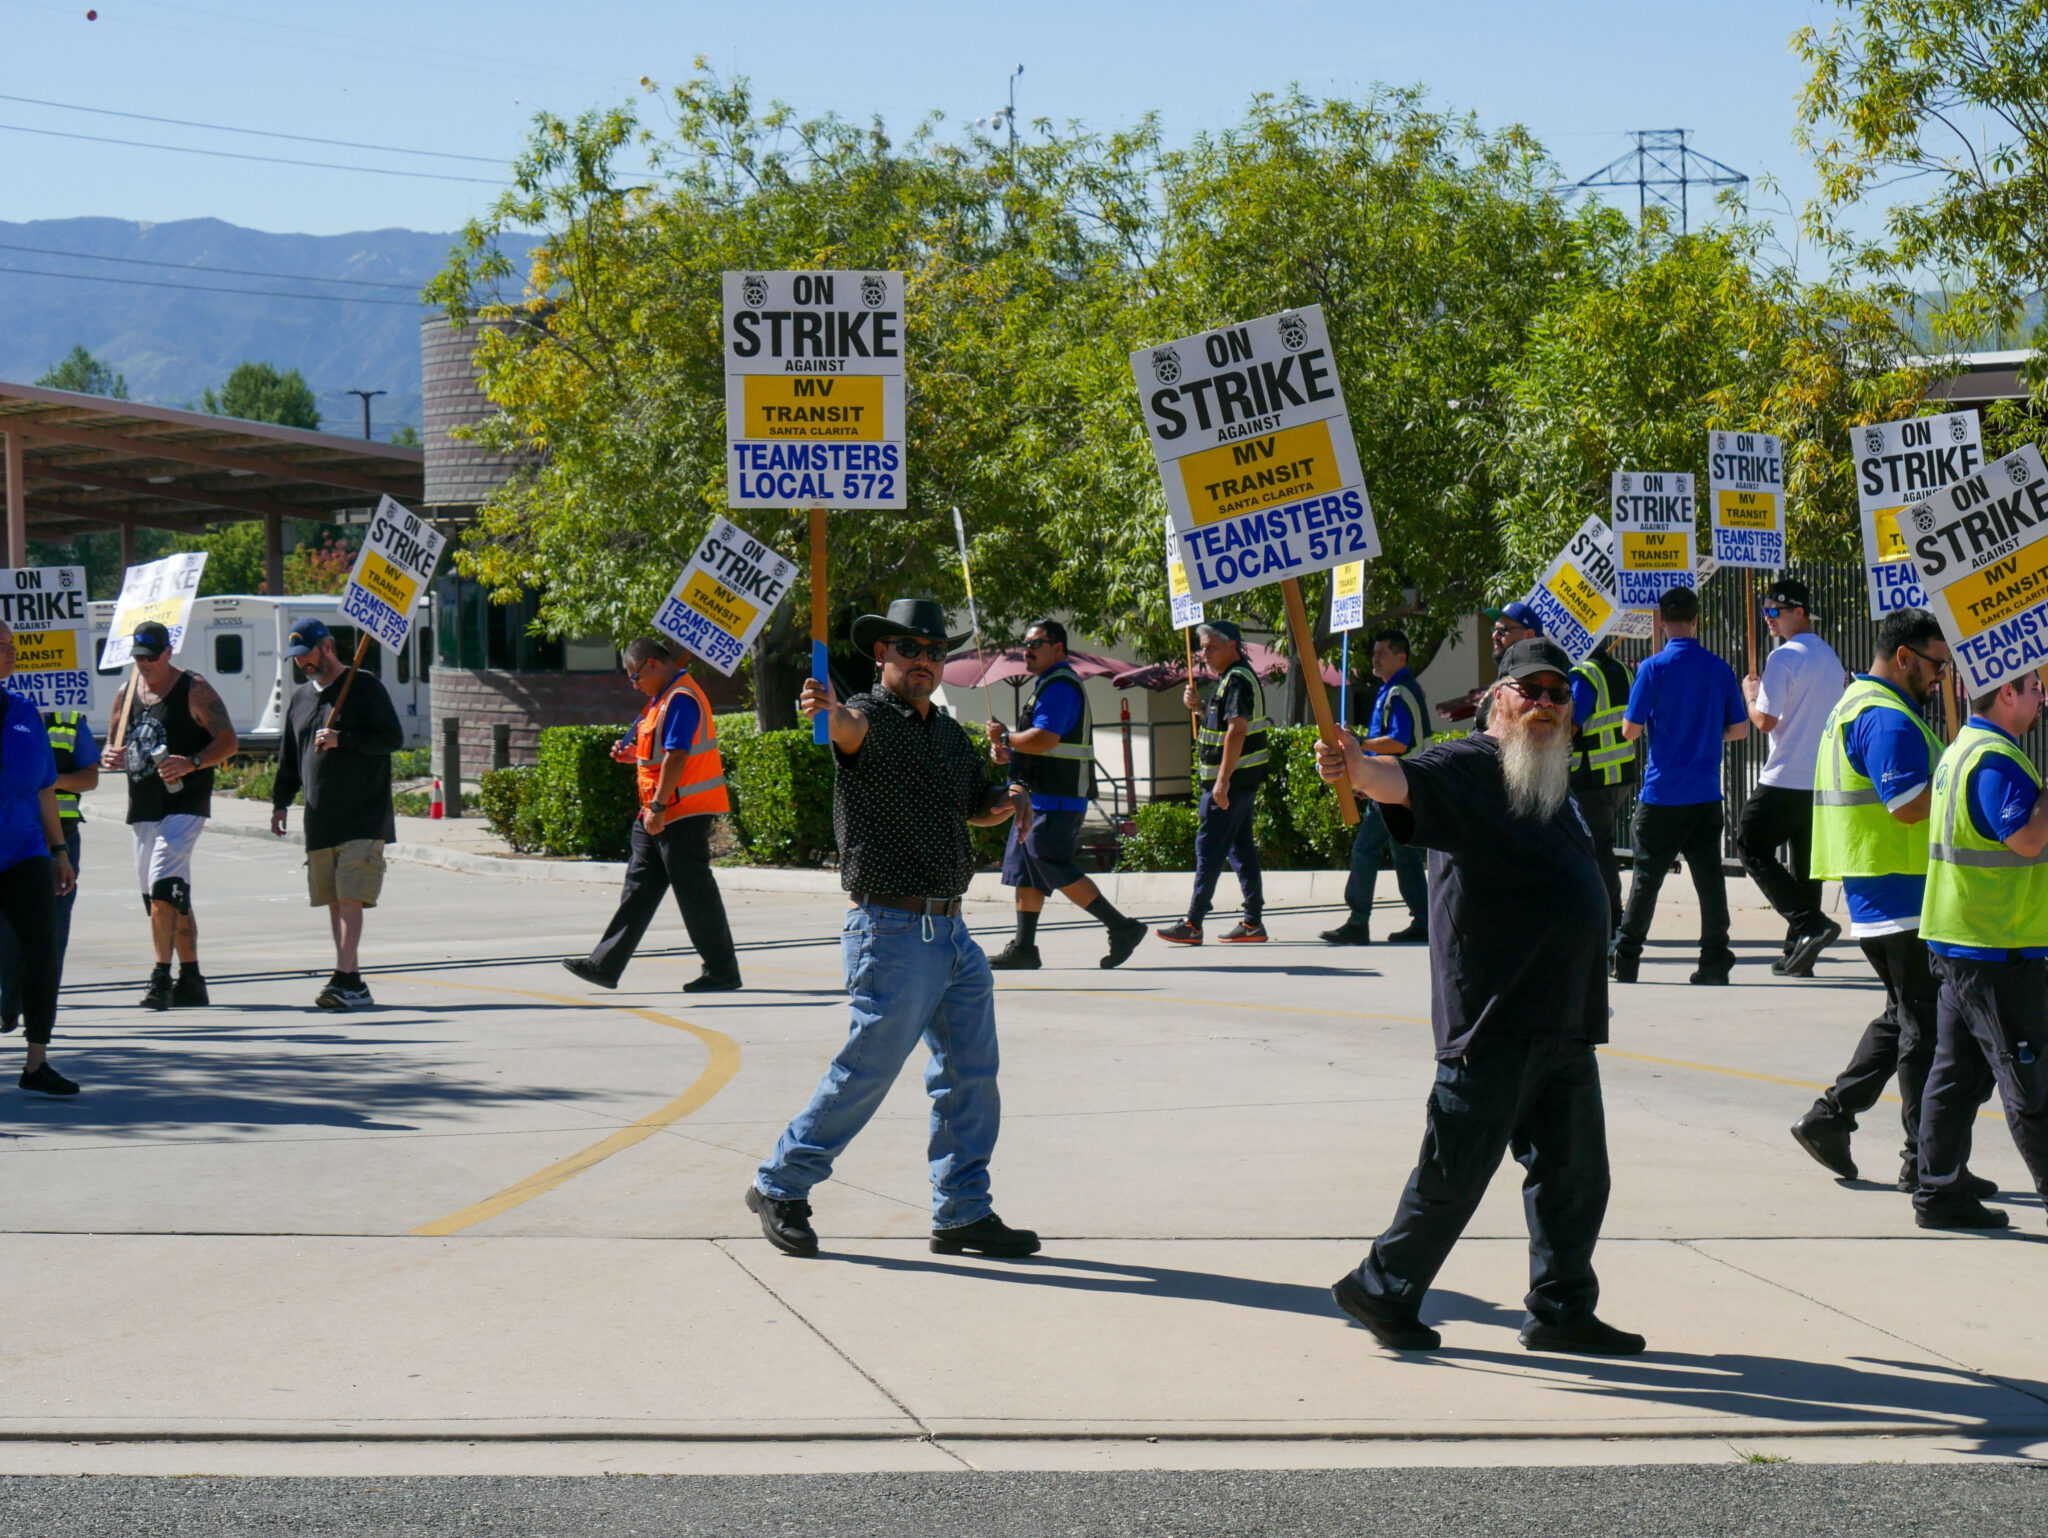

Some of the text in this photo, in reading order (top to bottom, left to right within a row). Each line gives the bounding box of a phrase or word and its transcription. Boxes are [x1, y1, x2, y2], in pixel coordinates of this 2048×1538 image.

[793, 275, 834, 305] ON
[733, 311, 898, 358] STRIKE
[1205, 327, 1254, 369] ON
[785, 360, 845, 372] AGAINST
[794, 379, 834, 396] MV
[1151, 348, 1336, 440] STRIKE
[762, 407, 864, 422] TRANSIT
[769, 427, 859, 436] SANTA CLARITA
[1218, 413, 1281, 442] AGAINST
[1902, 421, 1932, 448] ON
[1232, 436, 1276, 466] MV
[1737, 435, 1754, 452] ON
[734, 444, 899, 471] TEAMSTERS
[1713, 454, 1780, 483] STRIKE
[1861, 443, 1978, 496] STRIKE
[740, 473, 894, 499] LOCAL 572
[1204, 458, 1315, 501] TRANSIT
[1643, 475, 1663, 492] ON
[1735, 481, 1760, 491] AGAINST
[1218, 482, 1315, 514] SANTA CLARITA
[1739, 494, 1756, 504] MV
[1951, 474, 1990, 512] ON
[1616, 495, 1693, 523] STRIKE
[1726, 508, 1768, 520] TRANSIT
[404, 514, 422, 537] ON
[1184, 490, 1363, 560] TEAMSTERS
[1640, 523, 1669, 531] AGAINST
[1915, 478, 2048, 577] STRIKE
[372, 517, 436, 579] STRIKE
[1646, 534, 1665, 545] MV
[1715, 529, 1782, 548] TEAMSTERS
[386, 553, 410, 573] AGAINST
[742, 540, 766, 563] ON
[1197, 540, 1302, 591] LOCAL
[1309, 523, 1367, 561] 572
[1630, 550, 1680, 560] TRANSIT
[1718, 545, 1781, 563] LOCAL 572
[1972, 537, 2020, 569] AGAINST
[384, 564, 402, 581] MV
[700, 538, 784, 607] STRIKE
[1344, 564, 1352, 574] MV
[1571, 533, 1616, 597] STRI
[1984, 556, 2018, 587] MV
[15, 570, 42, 590] ON
[368, 569, 406, 601] TRANSIT
[717, 574, 747, 597] AGAINST
[1339, 576, 1357, 588] TRANSIT
[1577, 580, 1595, 600] MV
[1582, 569, 1605, 593] AGAINST
[1617, 572, 1695, 588] TEAMSTERS
[0, 590, 84, 621] TRIKE
[693, 588, 742, 625] TRANSIT
[713, 586, 737, 604] MV
[1334, 595, 1361, 613] TEAMSTERS
[1560, 579, 1597, 620] TRANSIT
[1878, 586, 1930, 611] LOC
[350, 582, 409, 635] TEAMSTERS
[1174, 606, 1201, 624] LOCAL 572
[1333, 609, 1360, 627] LOCAL 572
[1535, 583, 1595, 651] TEAMSTERS
[1980, 607, 2013, 626] SANTA
[14, 621, 51, 630] AGAINST
[344, 598, 402, 648] LOCAL 572
[666, 596, 744, 657] TEAMSTERS
[1956, 602, 2048, 665] TEAMST
[19, 634, 44, 645] MV
[659, 612, 734, 669] LOCAL 572
[1561, 634, 1584, 660] 572
[15, 649, 64, 661] ANSIT
[2, 671, 89, 691] AMSTERS
[55, 689, 88, 706] 572
